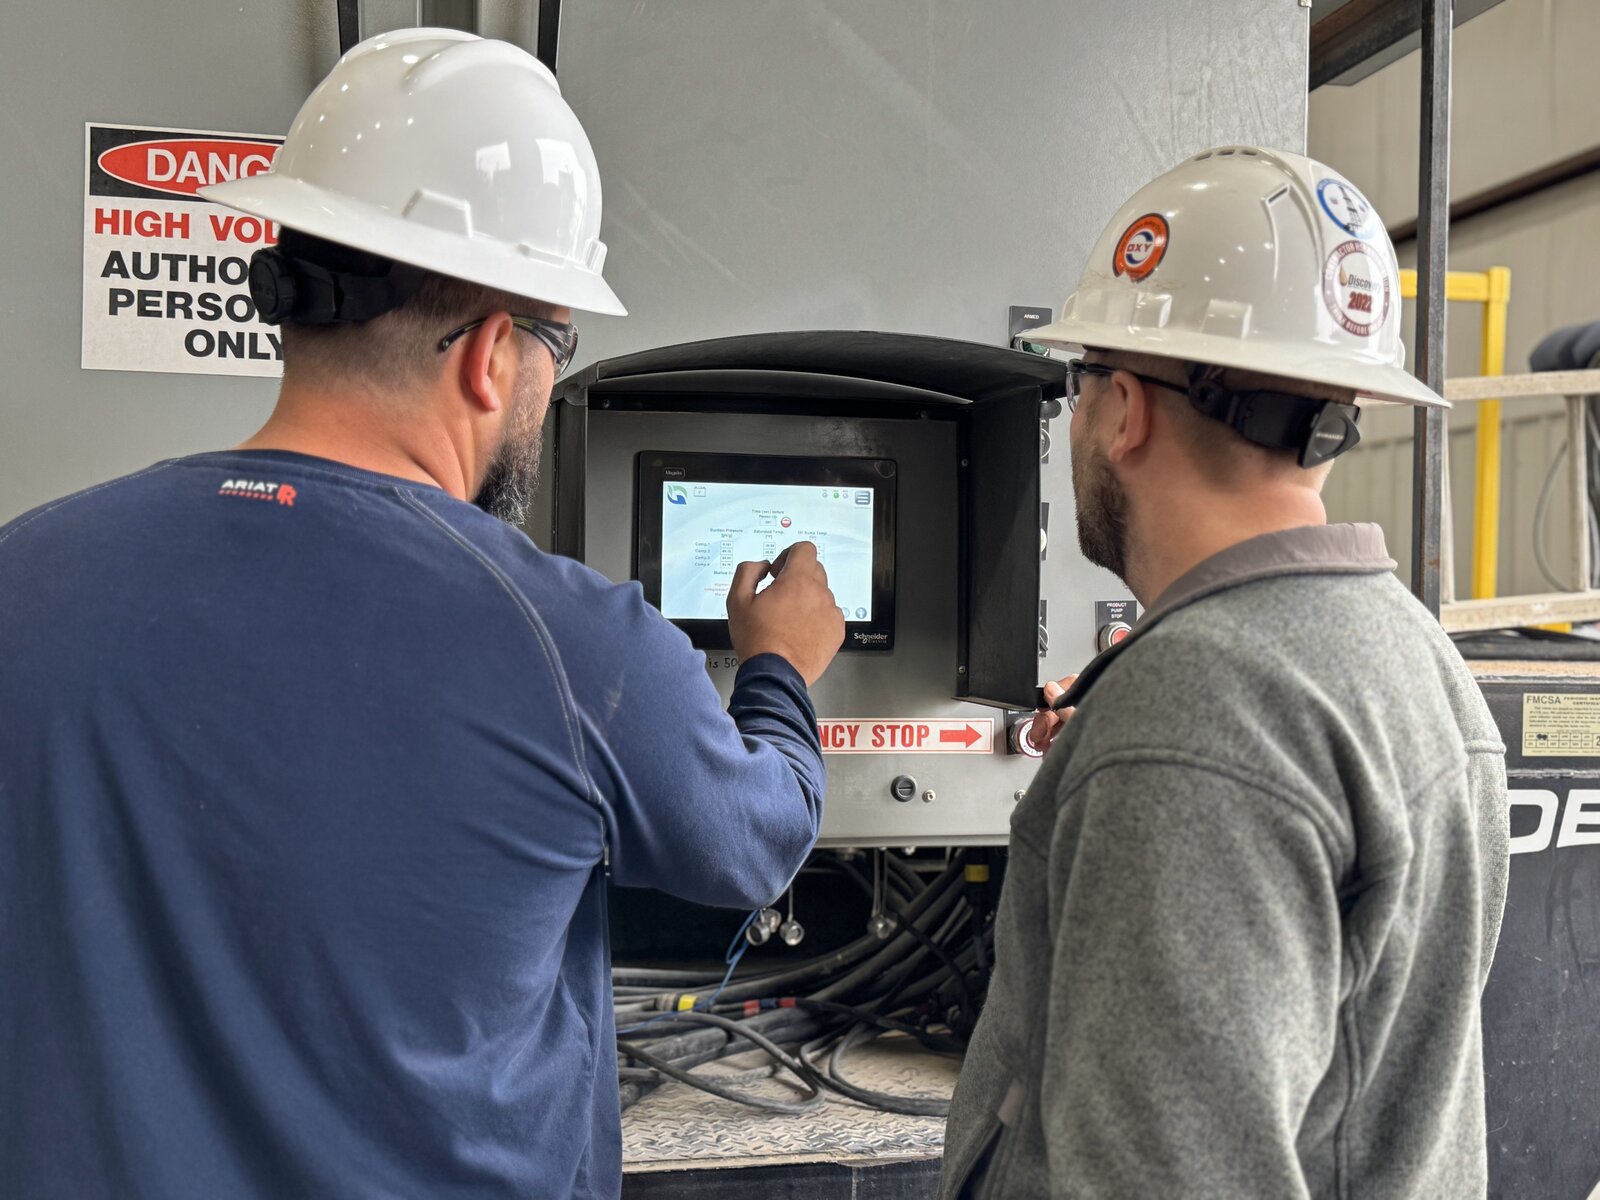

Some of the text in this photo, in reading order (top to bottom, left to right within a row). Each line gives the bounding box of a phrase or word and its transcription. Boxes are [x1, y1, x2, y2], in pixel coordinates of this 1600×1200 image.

[94, 208, 190, 239] HIGH
[1127, 243, 1152, 253] OXY
[109, 287, 279, 326] PERSO
[221, 479, 278, 493] ARIAT
[854, 632, 889, 644] Schneider
[708, 658, 719, 669] is
[1526, 695, 1562, 704] FMCSA
[871, 724, 930, 748] STOP
